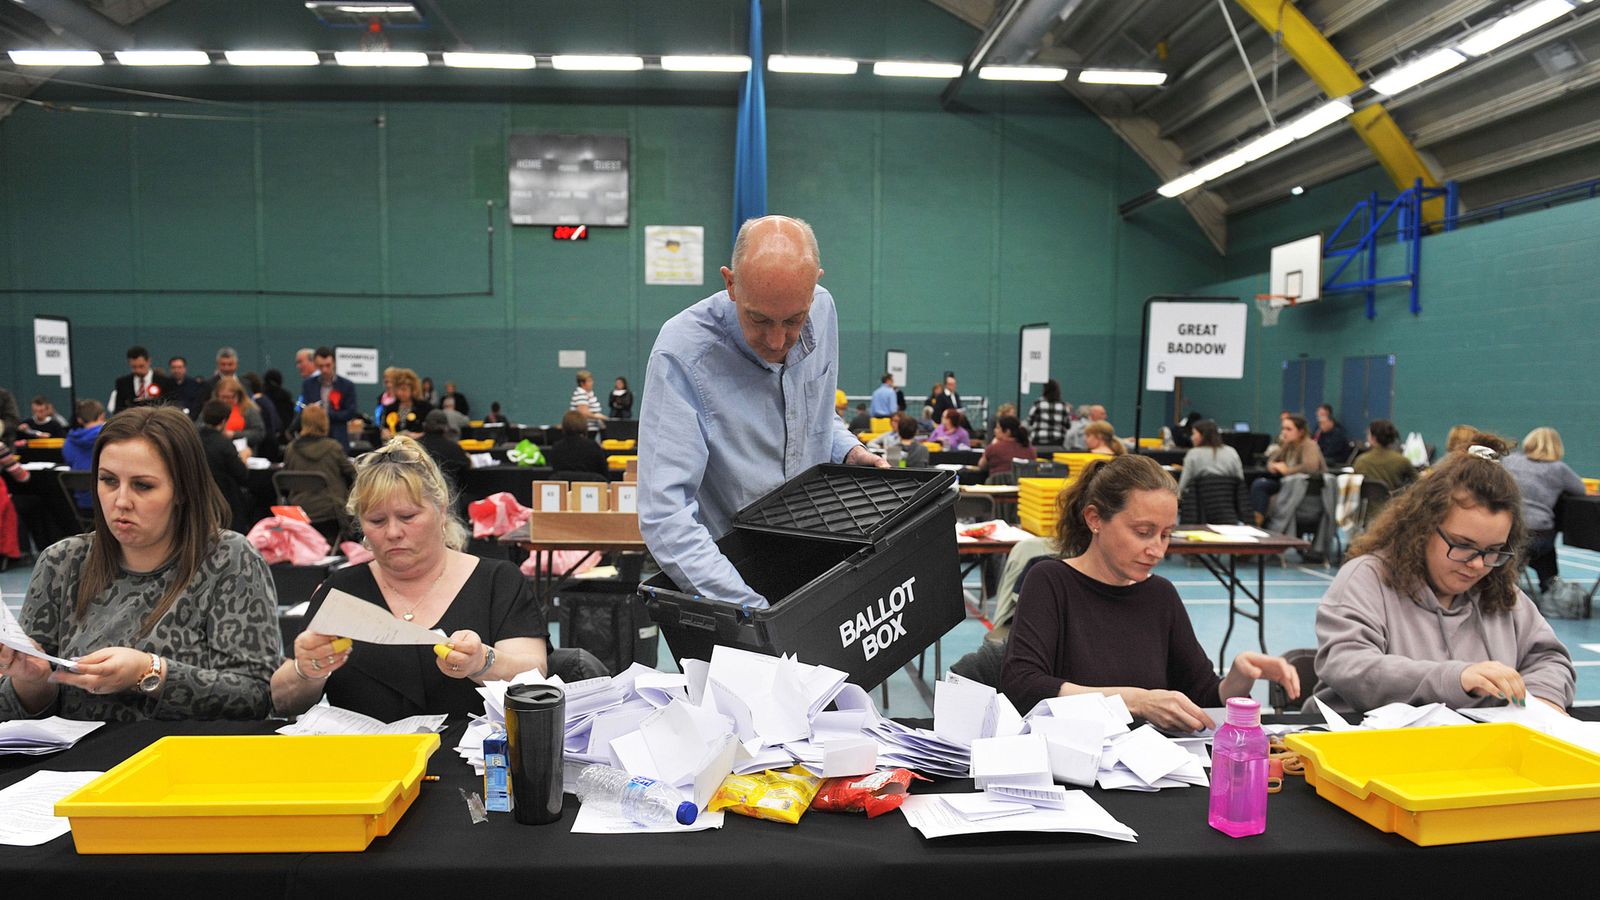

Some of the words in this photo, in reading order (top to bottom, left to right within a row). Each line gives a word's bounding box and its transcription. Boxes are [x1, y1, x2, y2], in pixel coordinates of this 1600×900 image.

[1178, 323, 1218, 336] GREAT
[1167, 342, 1226, 355] BADDOW
[1157, 362, 1166, 374] 6
[838, 576, 916, 648] BALLOT
[861, 612, 907, 662] BOX
